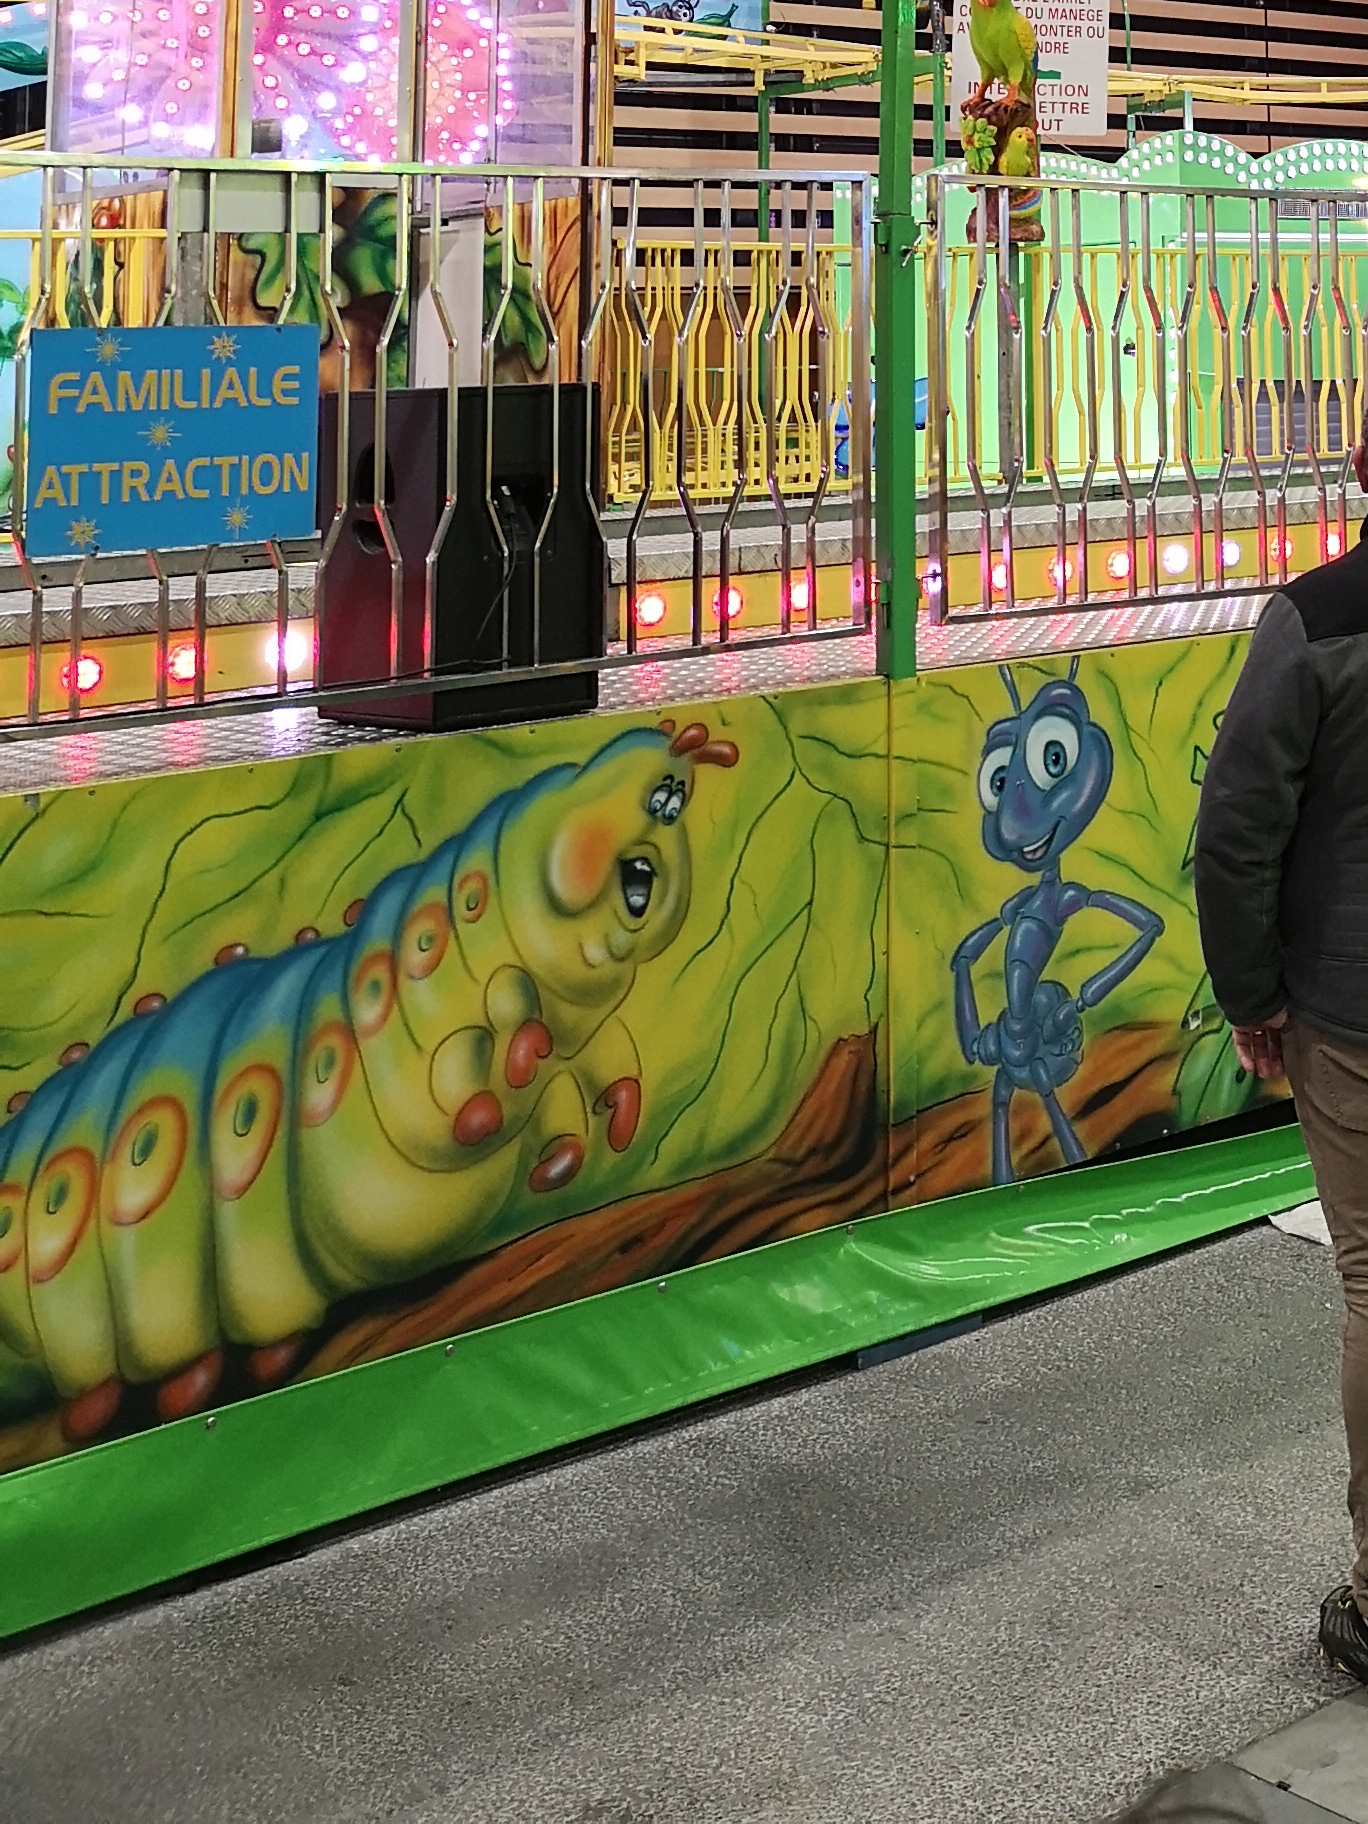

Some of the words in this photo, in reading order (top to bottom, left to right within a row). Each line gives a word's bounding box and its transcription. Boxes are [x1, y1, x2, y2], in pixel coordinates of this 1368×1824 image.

[1026, 7, 1044, 20] DU
[1048, 8, 1103, 22] MANEGE
[1086, 27, 1105, 39] OU
[47, 365, 300, 415] FAMILIALE
[33, 452, 310, 509] ATTRACTION
